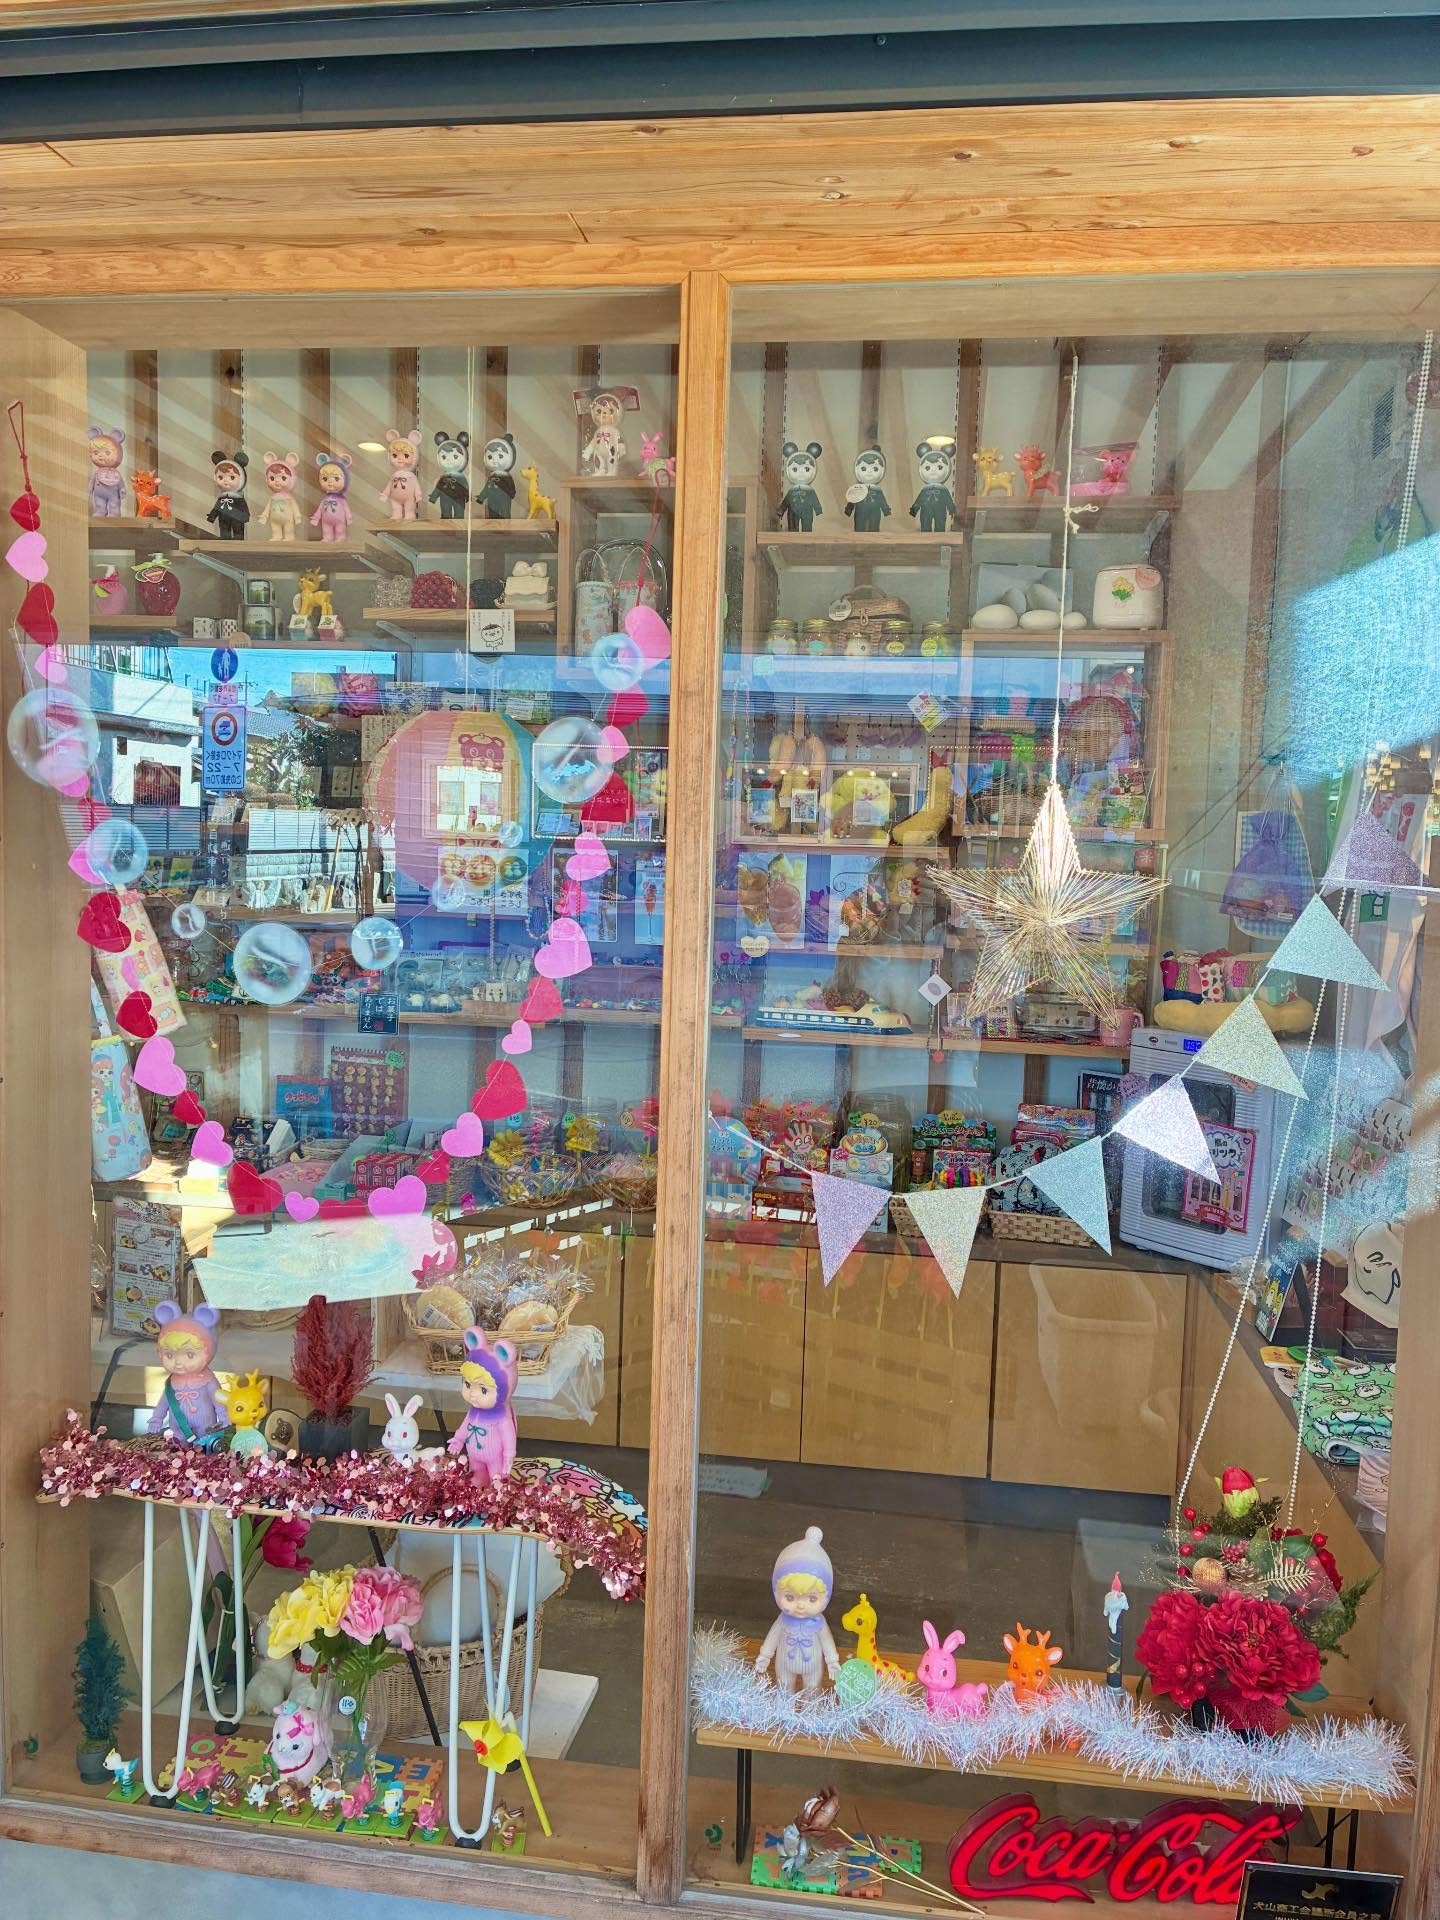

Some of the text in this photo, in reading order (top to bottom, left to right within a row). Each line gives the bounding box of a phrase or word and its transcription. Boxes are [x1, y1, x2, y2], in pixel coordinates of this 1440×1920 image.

[363, 996, 372, 1029] ありません
[375, 997, 386, 1012] では
[386, 998, 396, 1022] お菓子
